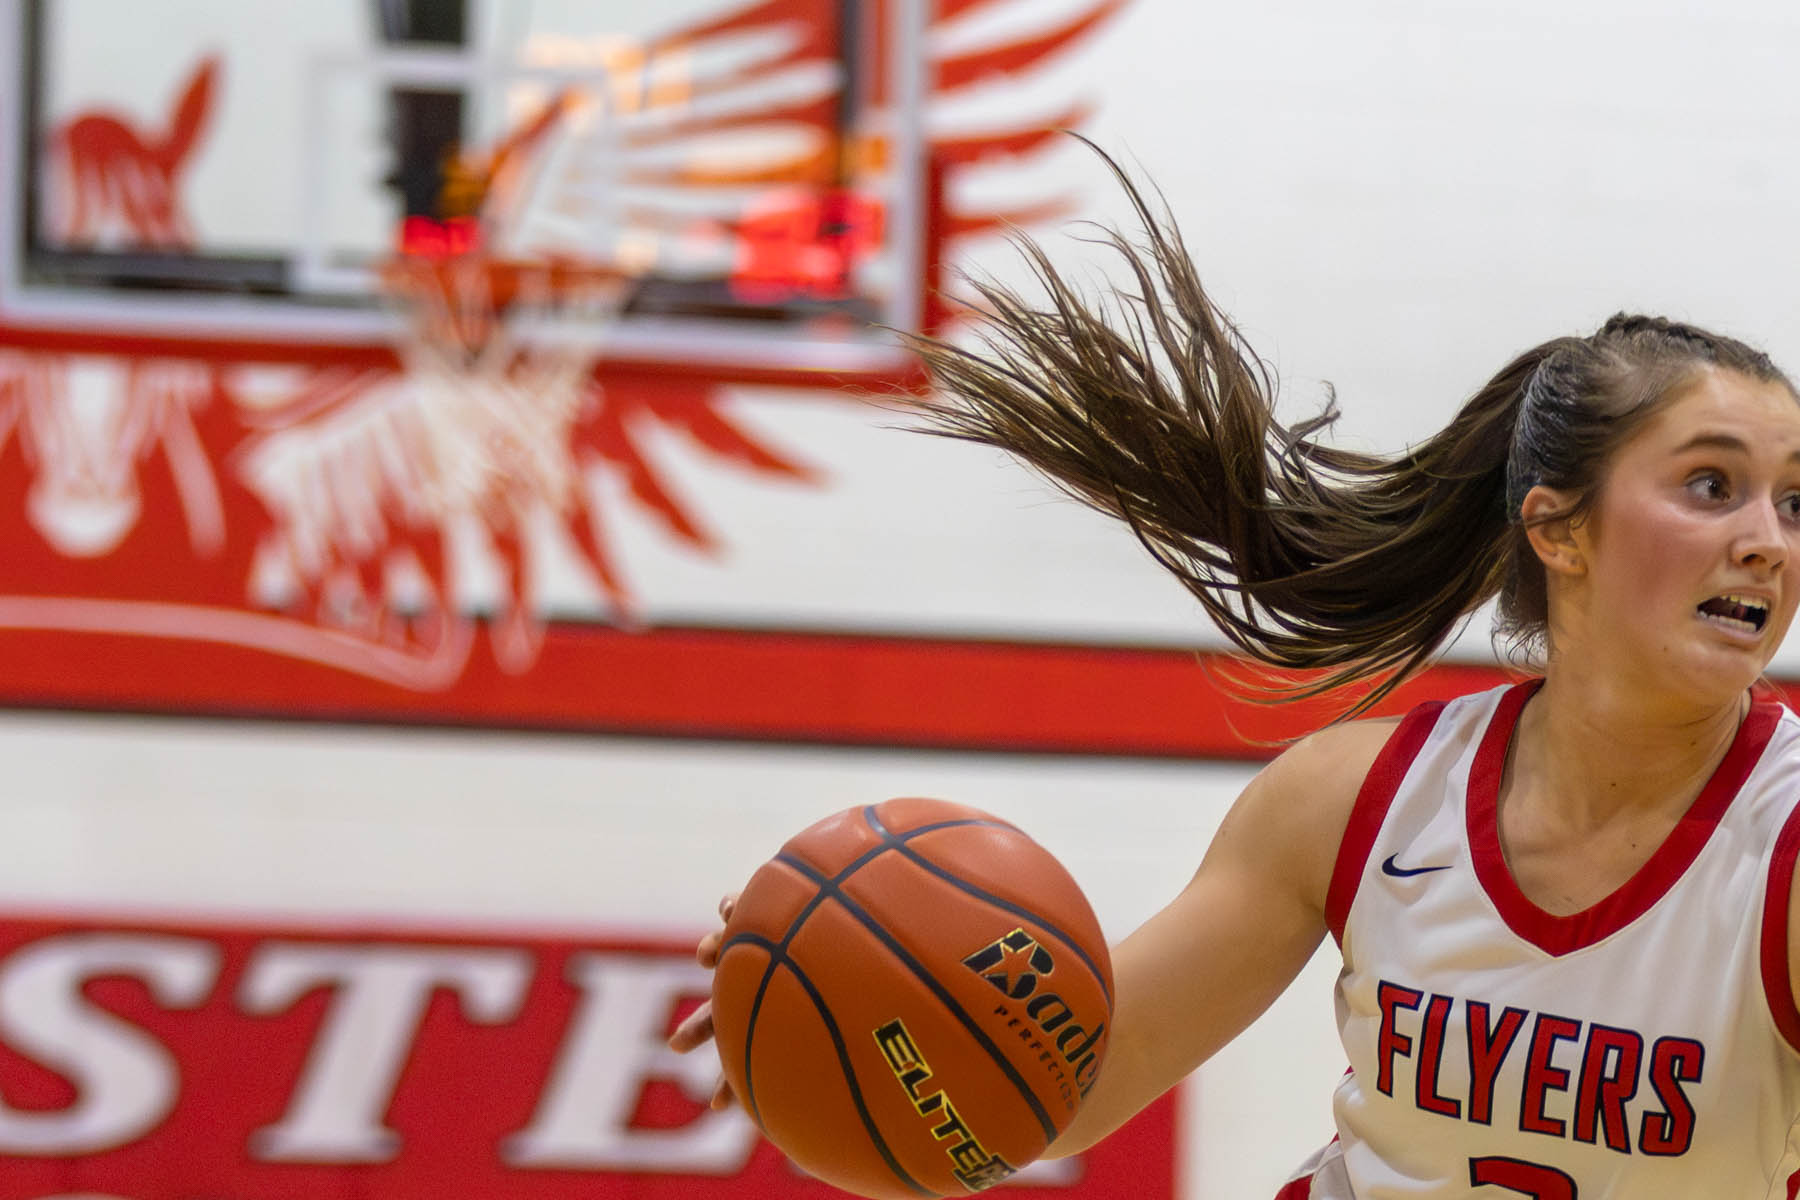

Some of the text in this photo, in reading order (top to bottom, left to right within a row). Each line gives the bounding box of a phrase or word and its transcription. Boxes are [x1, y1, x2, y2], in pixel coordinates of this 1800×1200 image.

[0, 934, 1085, 1187] STE
[872, 1017, 994, 1177] ELITE
[960, 927, 1104, 1100] Bade
[1376, 979, 1705, 1157] FLYERS
